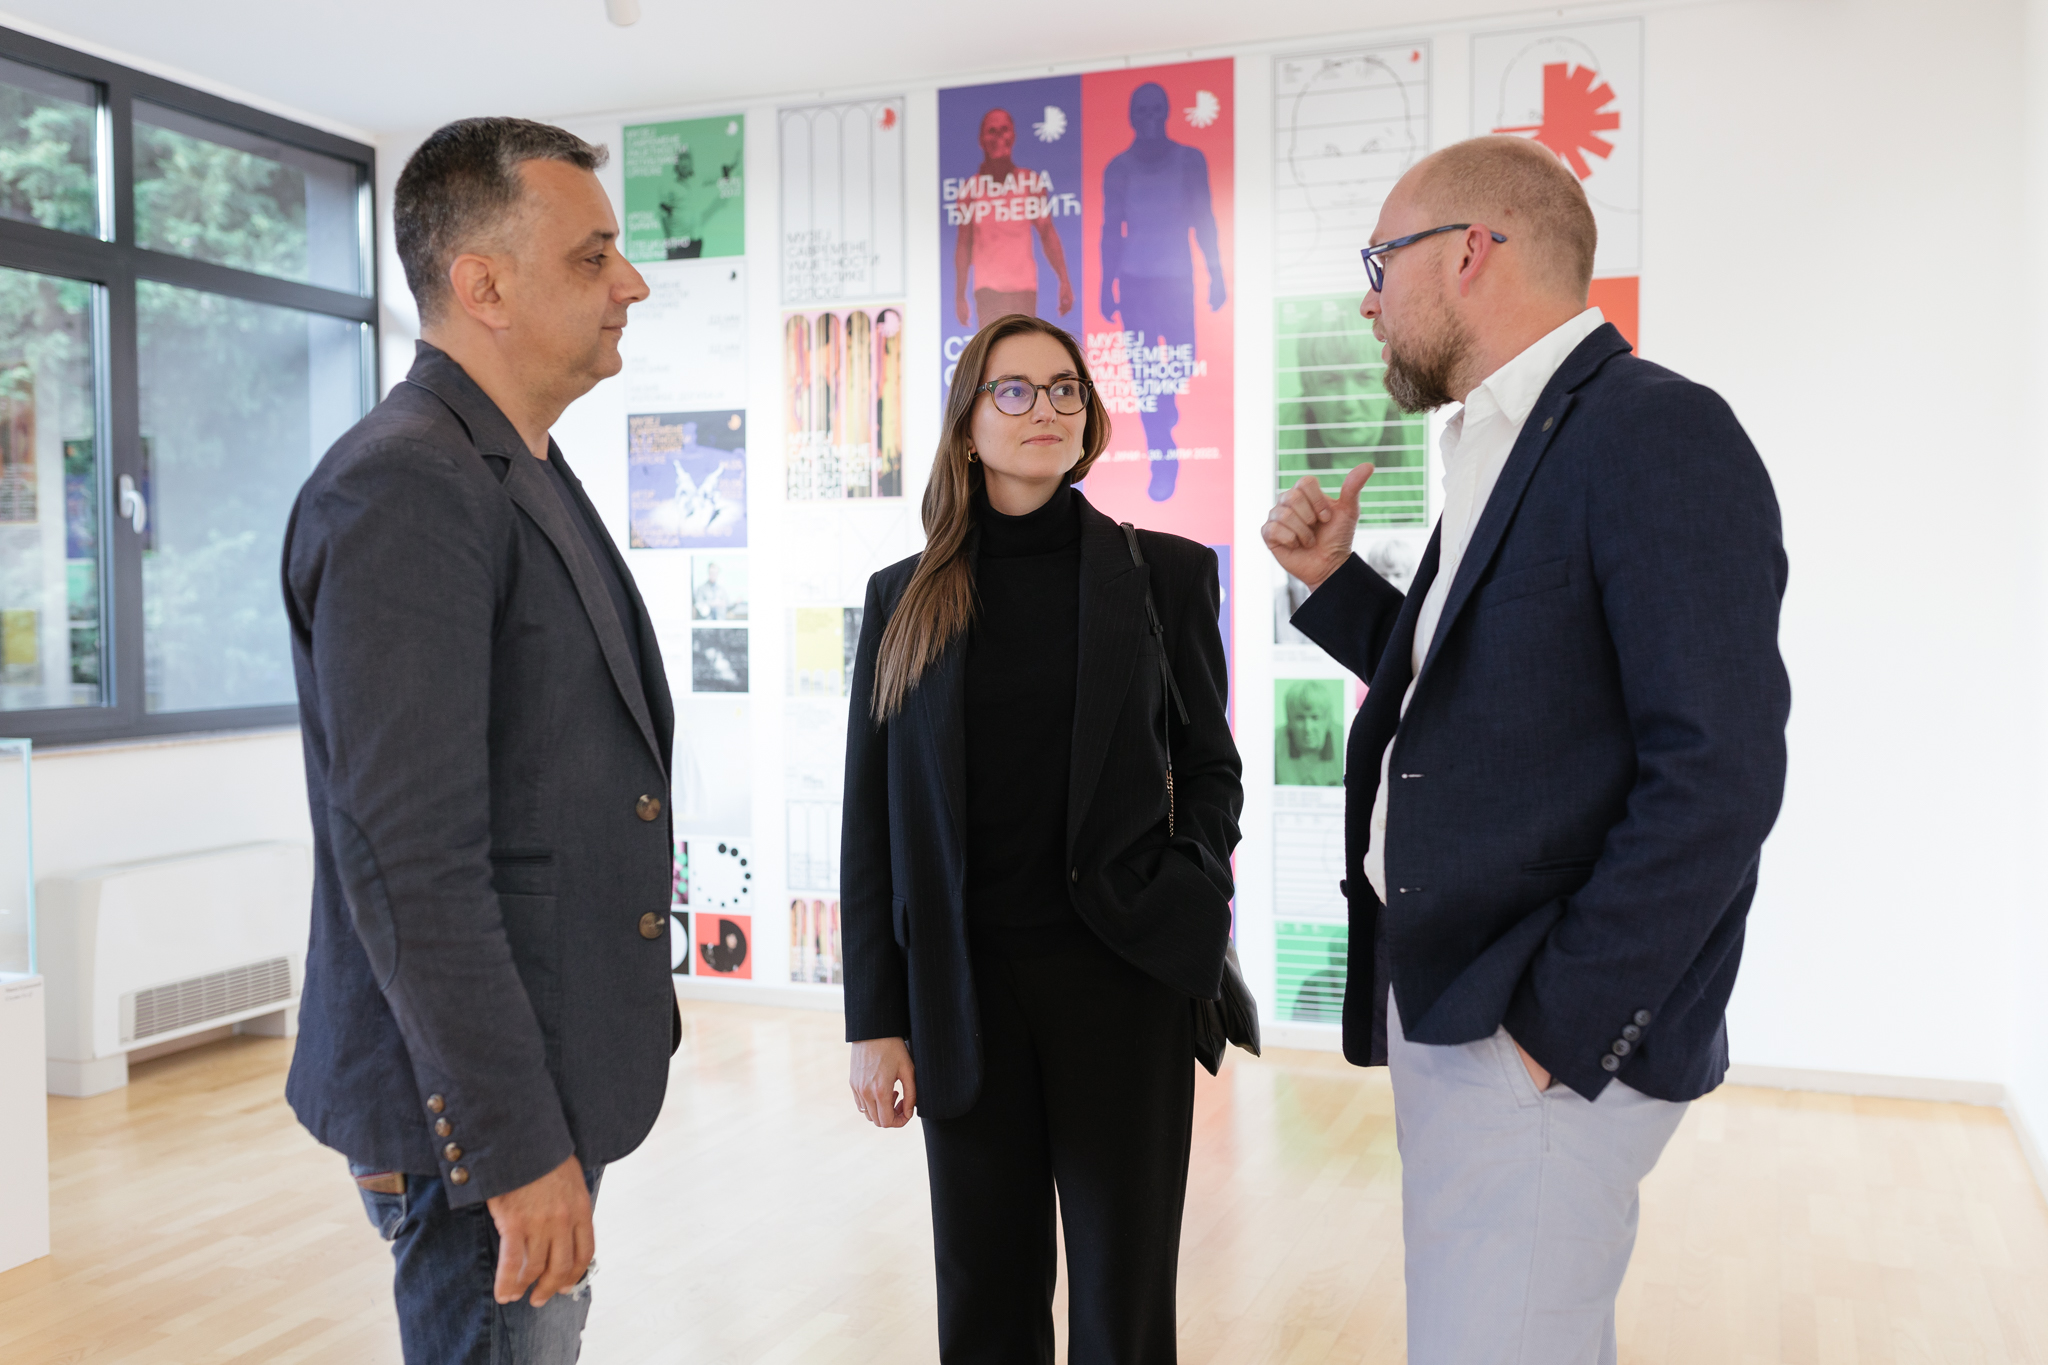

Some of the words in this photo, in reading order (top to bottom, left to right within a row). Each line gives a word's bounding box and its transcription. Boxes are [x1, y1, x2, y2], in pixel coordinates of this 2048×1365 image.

[943, 169, 1055, 202] БИЉАНА
[942, 192, 1082, 226] ЂУРЂЕВИЋ
[1086, 330, 1145, 348] МУЗЕЈ
[1087, 343, 1194, 366] САВРЕМЕНЕ
[1089, 359, 1208, 380] УМЈЕТНОСТИ
